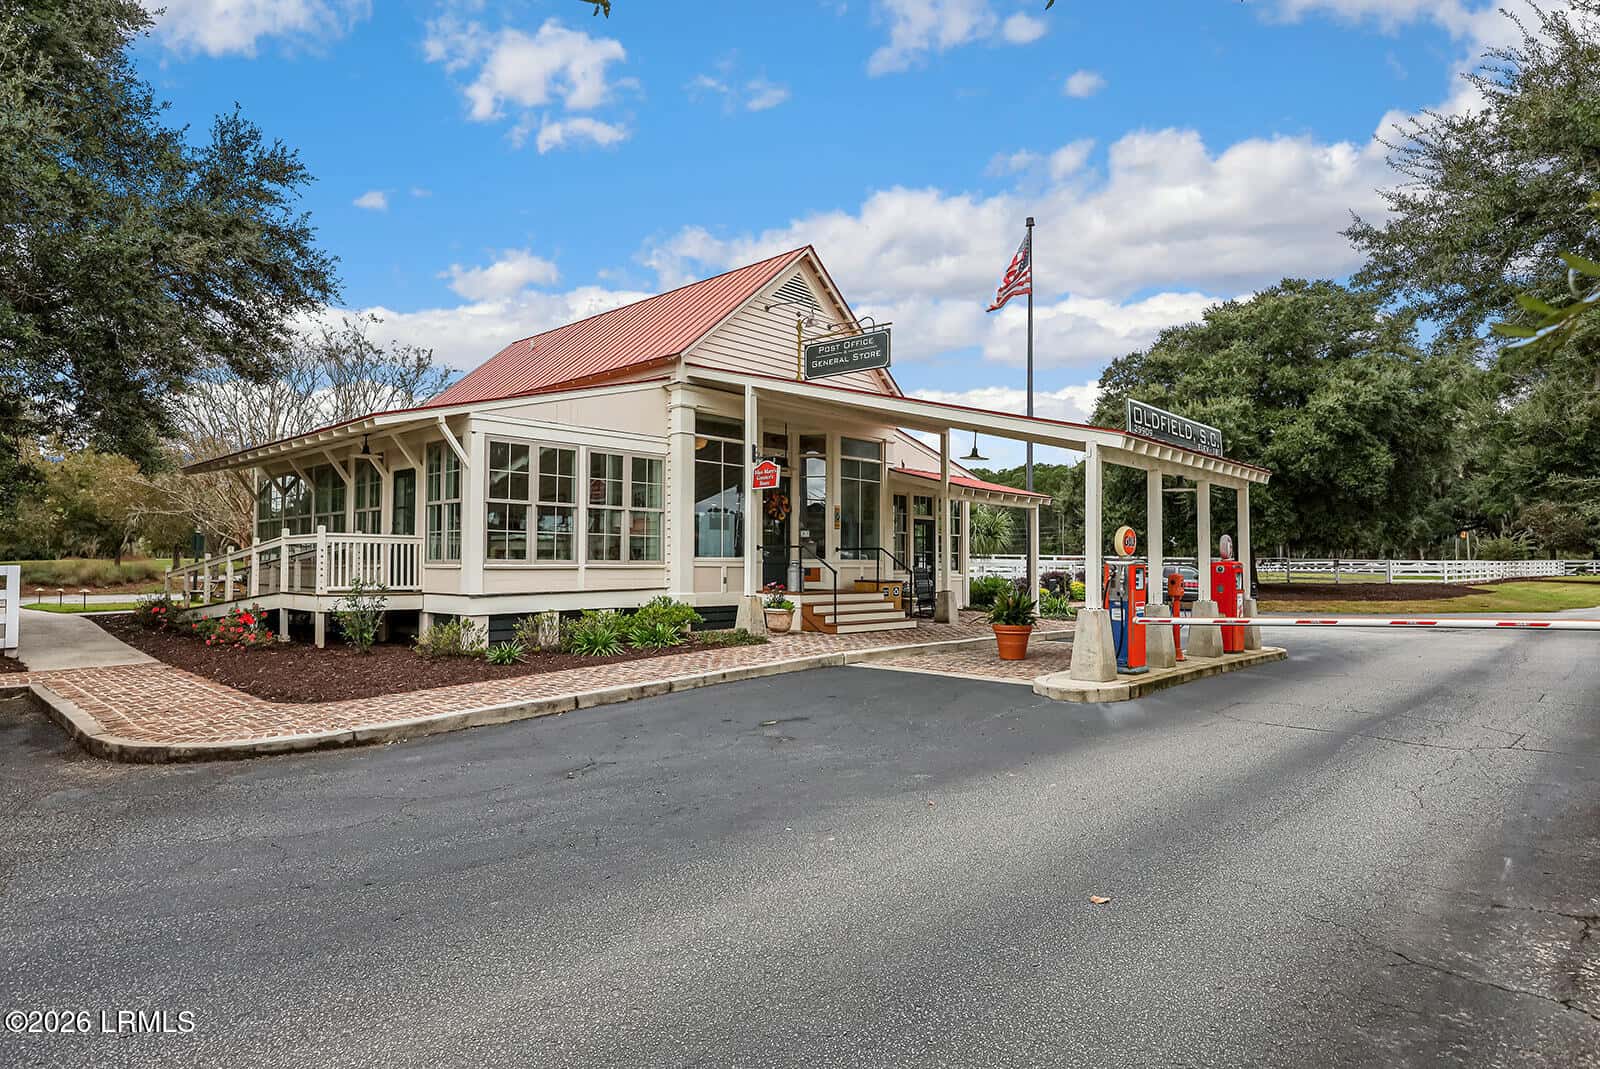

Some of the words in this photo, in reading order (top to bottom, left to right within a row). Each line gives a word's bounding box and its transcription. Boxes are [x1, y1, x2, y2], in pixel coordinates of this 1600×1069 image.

[818, 344, 840, 353] POST
[843, 338, 874, 349] OFFICE
[811, 357, 849, 368] GENERAL
[852, 350, 881, 361] STORE
